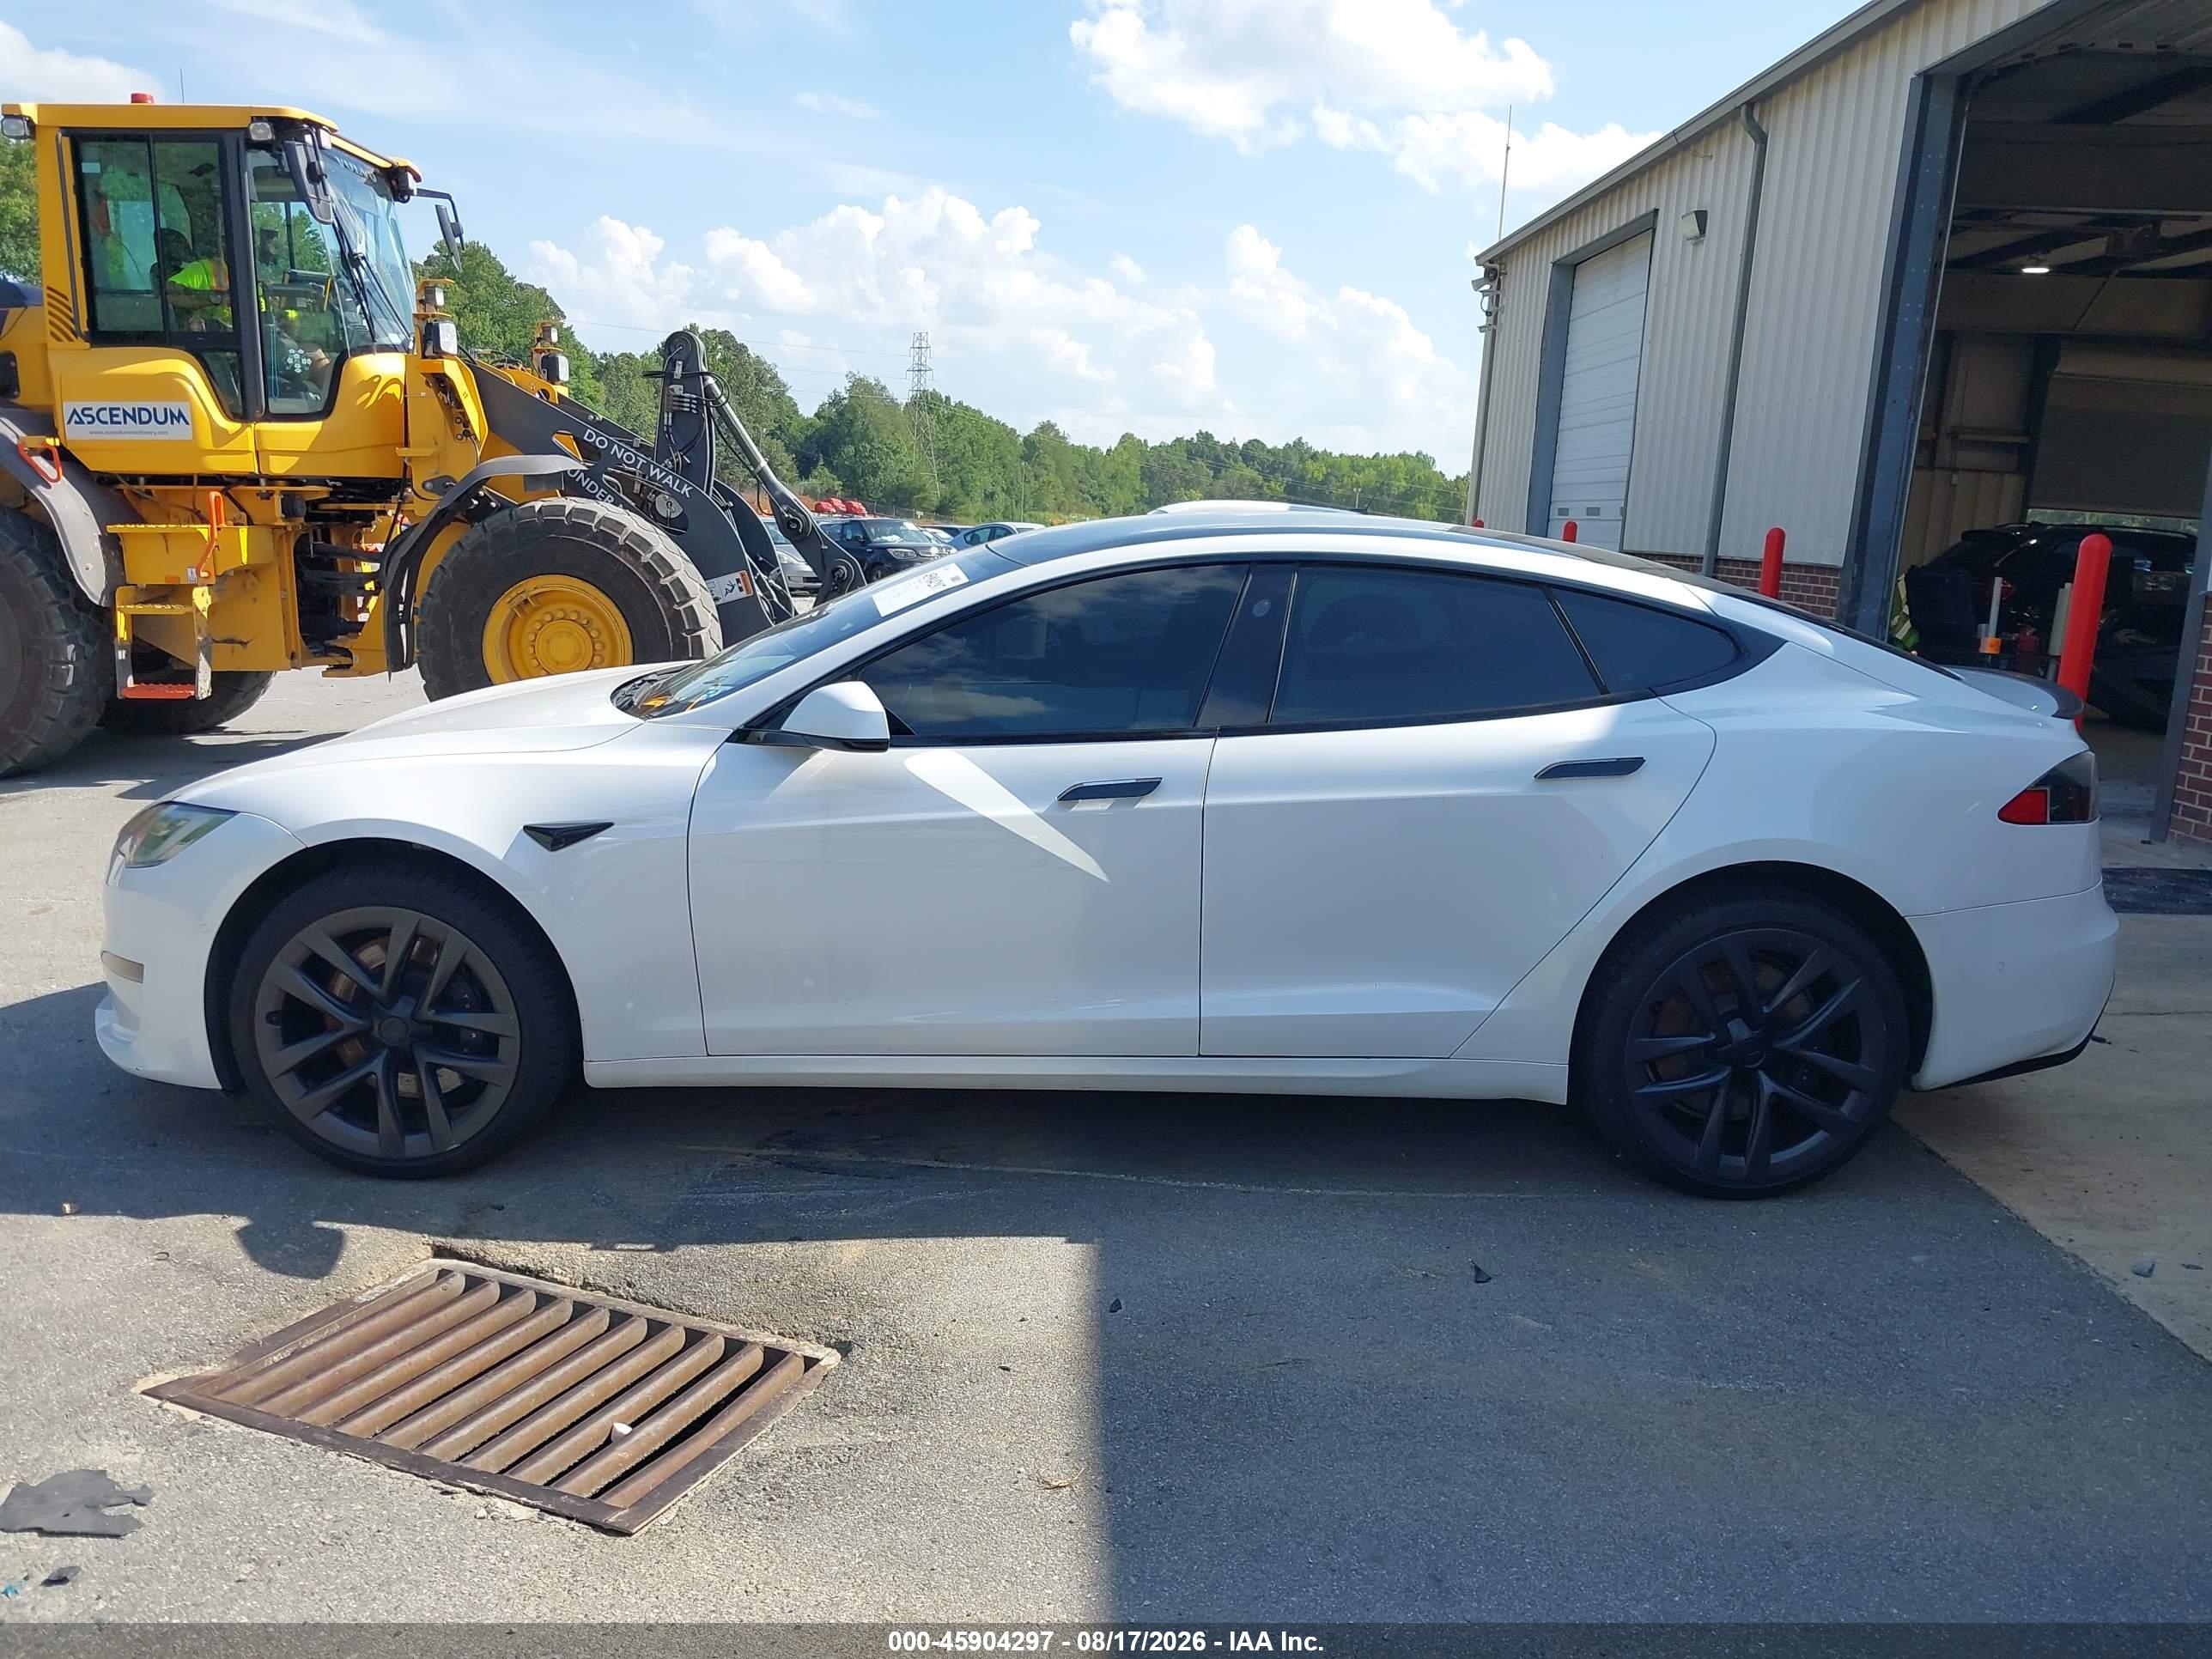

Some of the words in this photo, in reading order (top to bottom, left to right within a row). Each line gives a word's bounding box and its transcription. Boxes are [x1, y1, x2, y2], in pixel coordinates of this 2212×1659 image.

[66, 407, 191, 426] ASCENDUM
[583, 428, 609, 449] DO
[610, 444, 647, 470] NOT
[648, 464, 694, 499] WALK
[567, 468, 615, 505] UNDER
